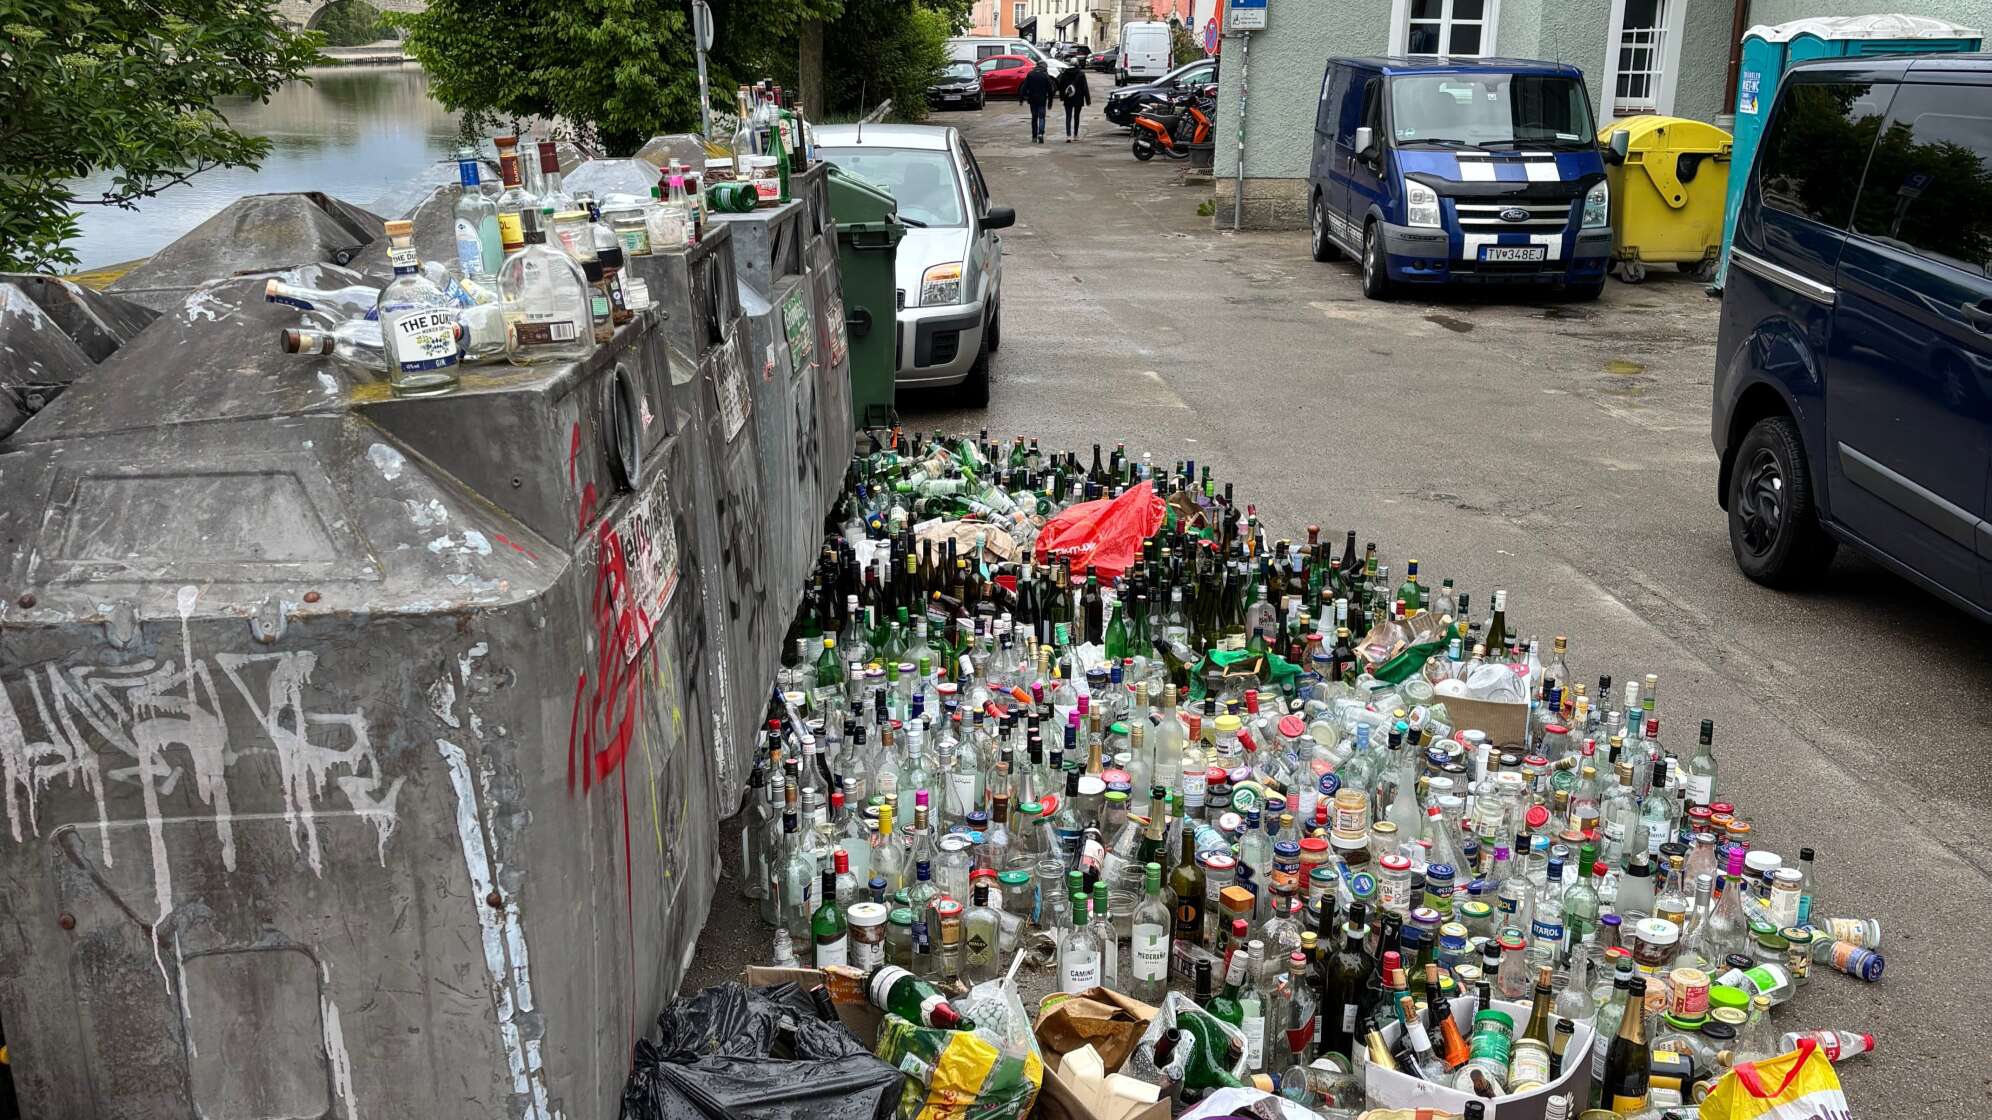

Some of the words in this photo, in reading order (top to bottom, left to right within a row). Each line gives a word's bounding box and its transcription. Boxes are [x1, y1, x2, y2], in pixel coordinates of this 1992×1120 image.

[393, 254, 406, 263] THE
[400, 317, 428, 334] THE
[1070, 968, 1094, 977] CAMINO
